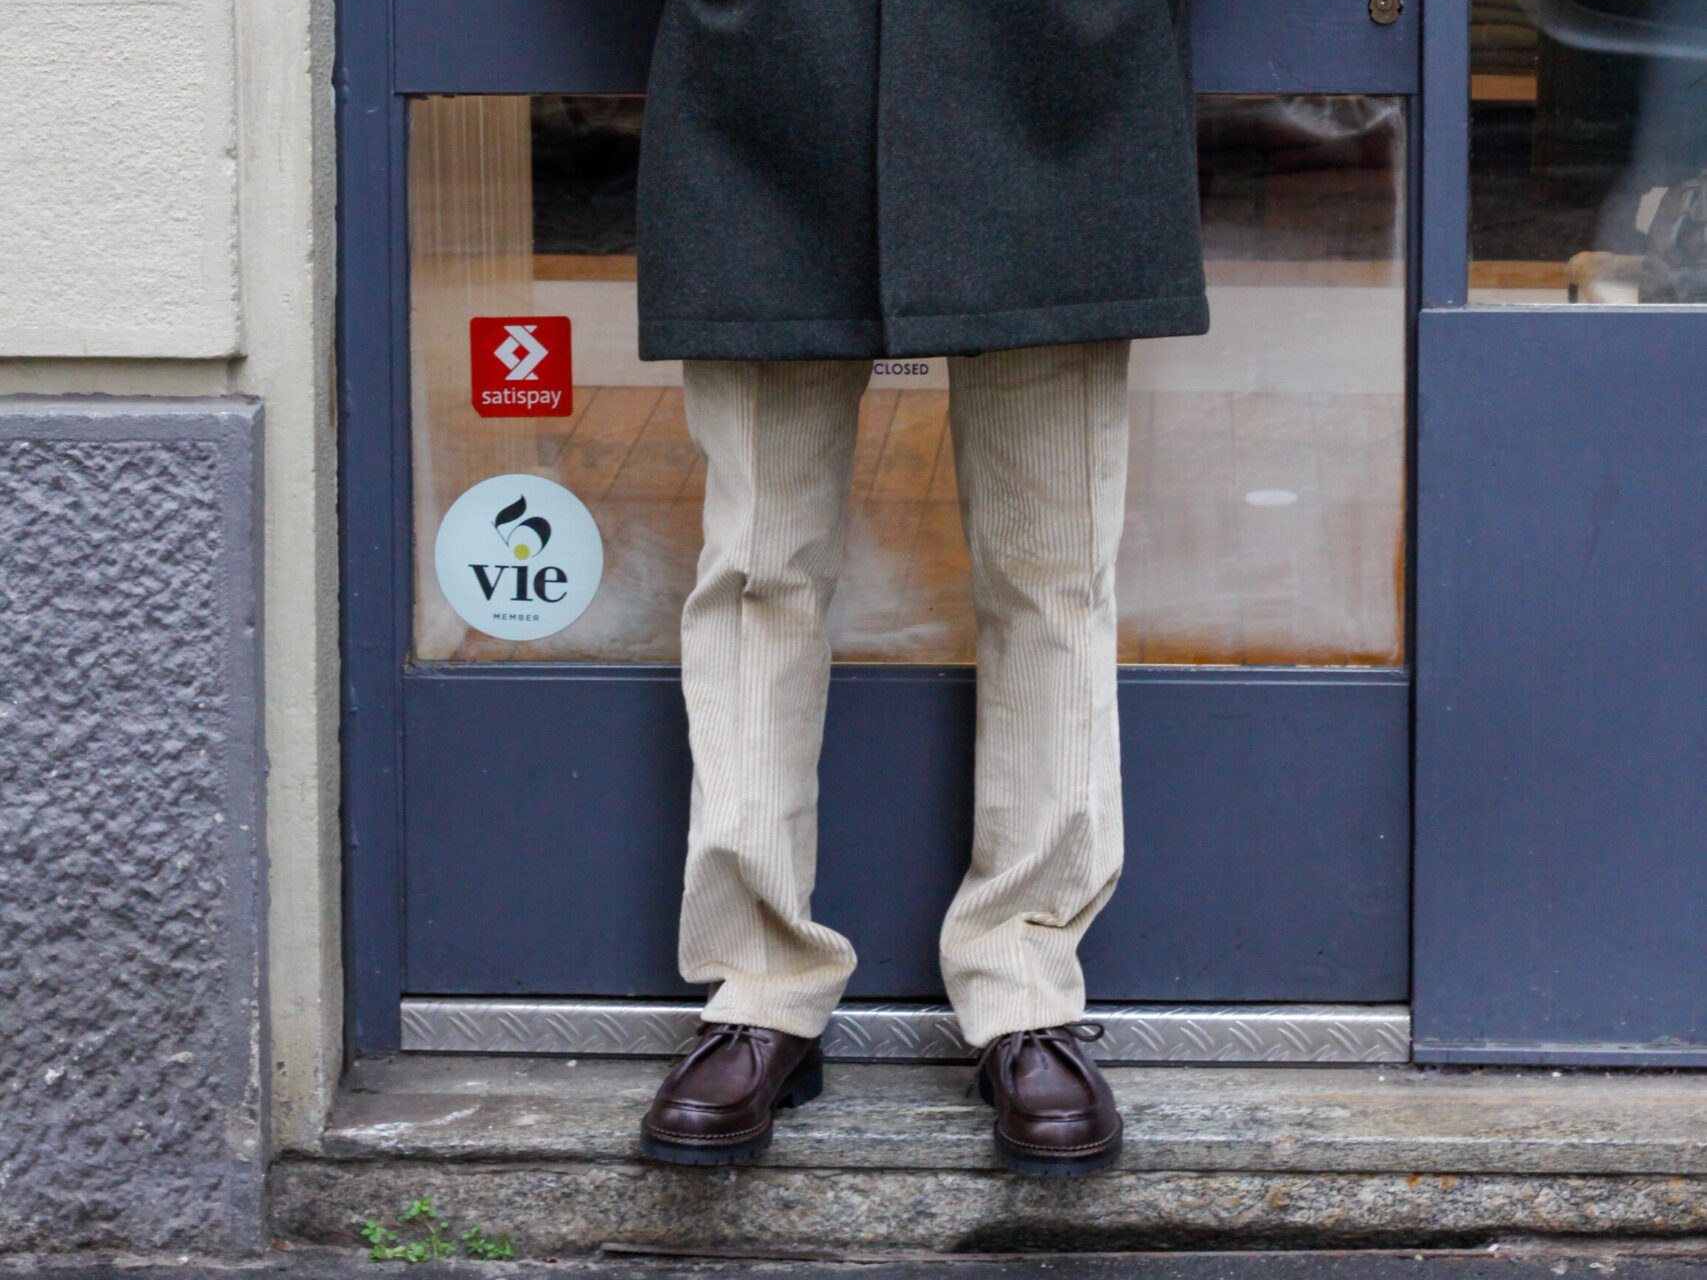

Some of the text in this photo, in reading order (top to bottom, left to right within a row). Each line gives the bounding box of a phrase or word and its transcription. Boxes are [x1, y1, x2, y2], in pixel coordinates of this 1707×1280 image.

[873, 363, 929, 375] CLOSED
[481, 387, 562, 409] satispay
[468, 564, 568, 603] vie
[493, 613, 539, 621] MEMBER
